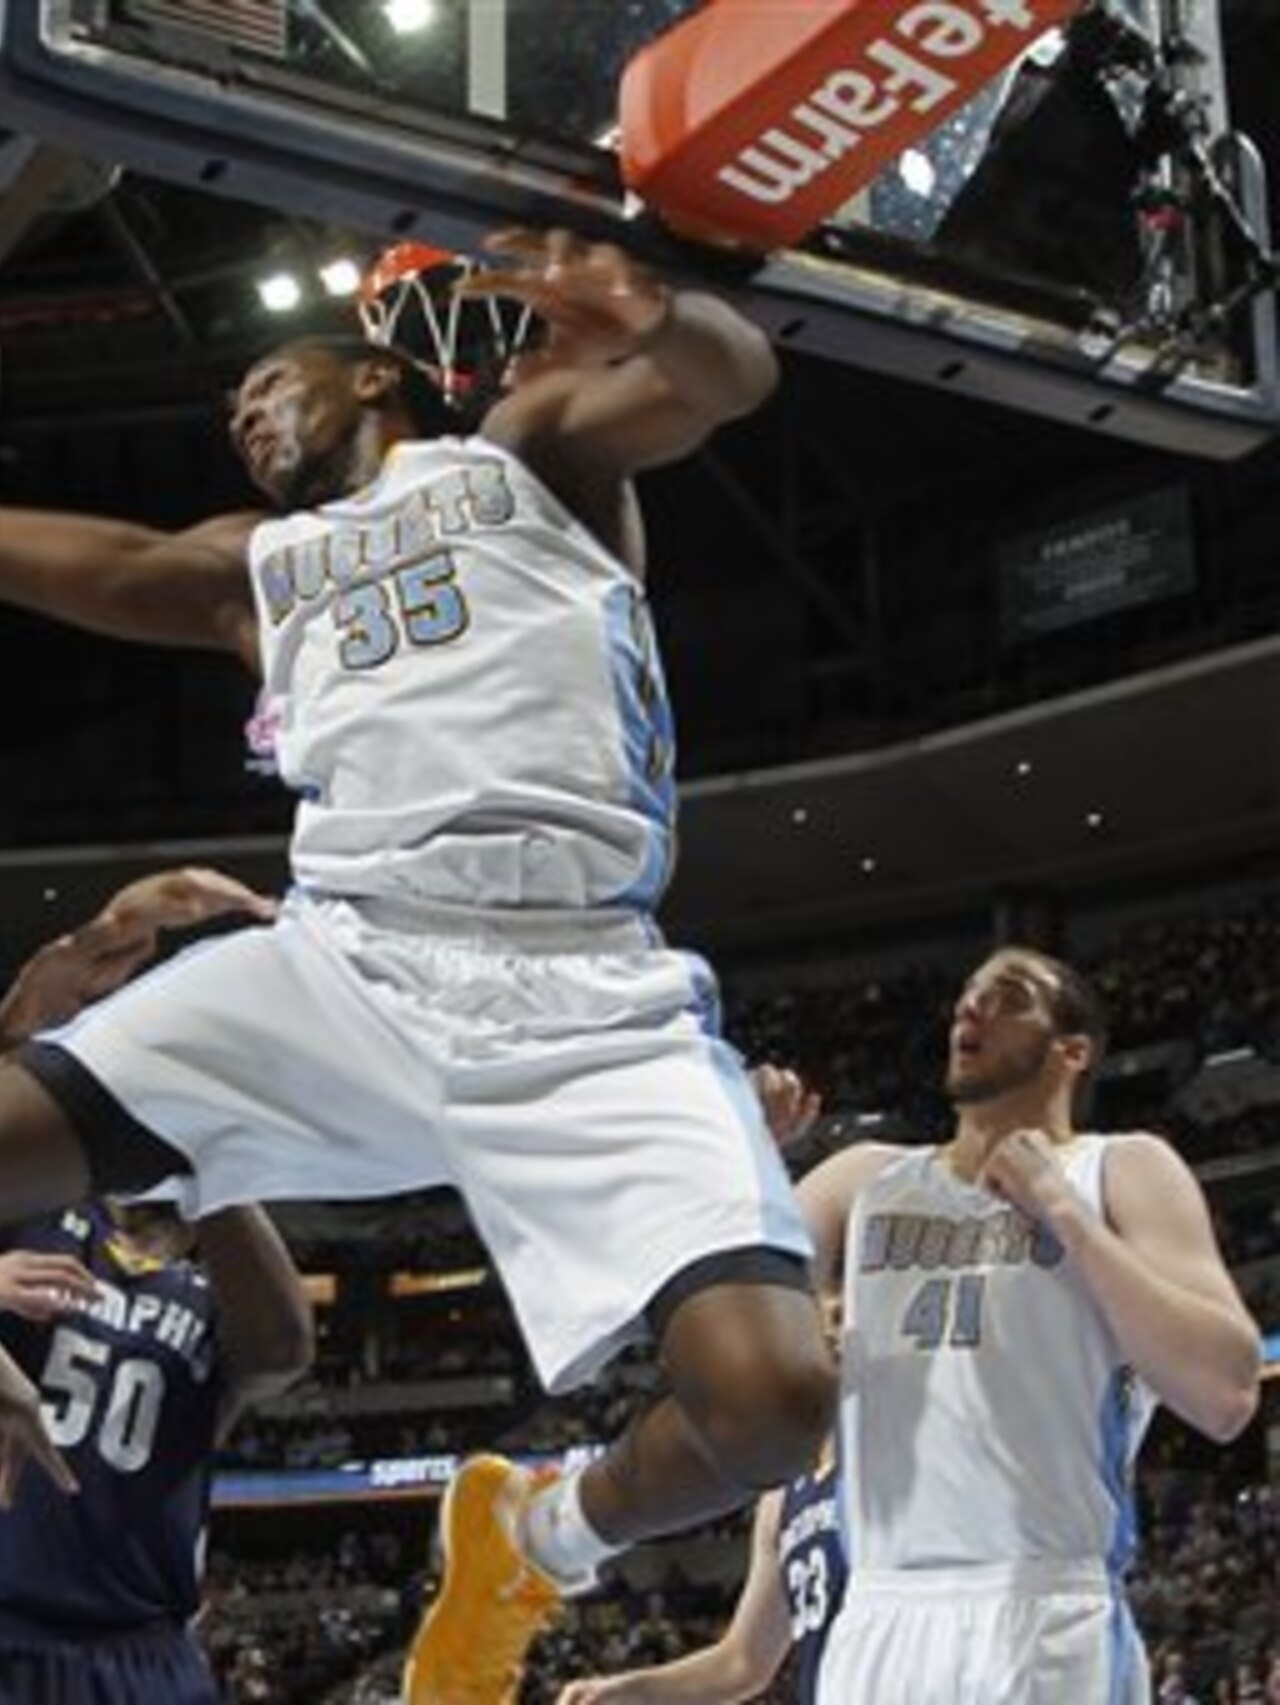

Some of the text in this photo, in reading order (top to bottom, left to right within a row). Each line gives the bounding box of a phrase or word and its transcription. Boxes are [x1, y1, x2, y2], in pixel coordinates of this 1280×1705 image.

[332, 552, 470, 670] 35
[901, 1273, 986, 1350] 41
[38, 1327, 166, 1472] 50
[788, 1547, 828, 1641] 33
